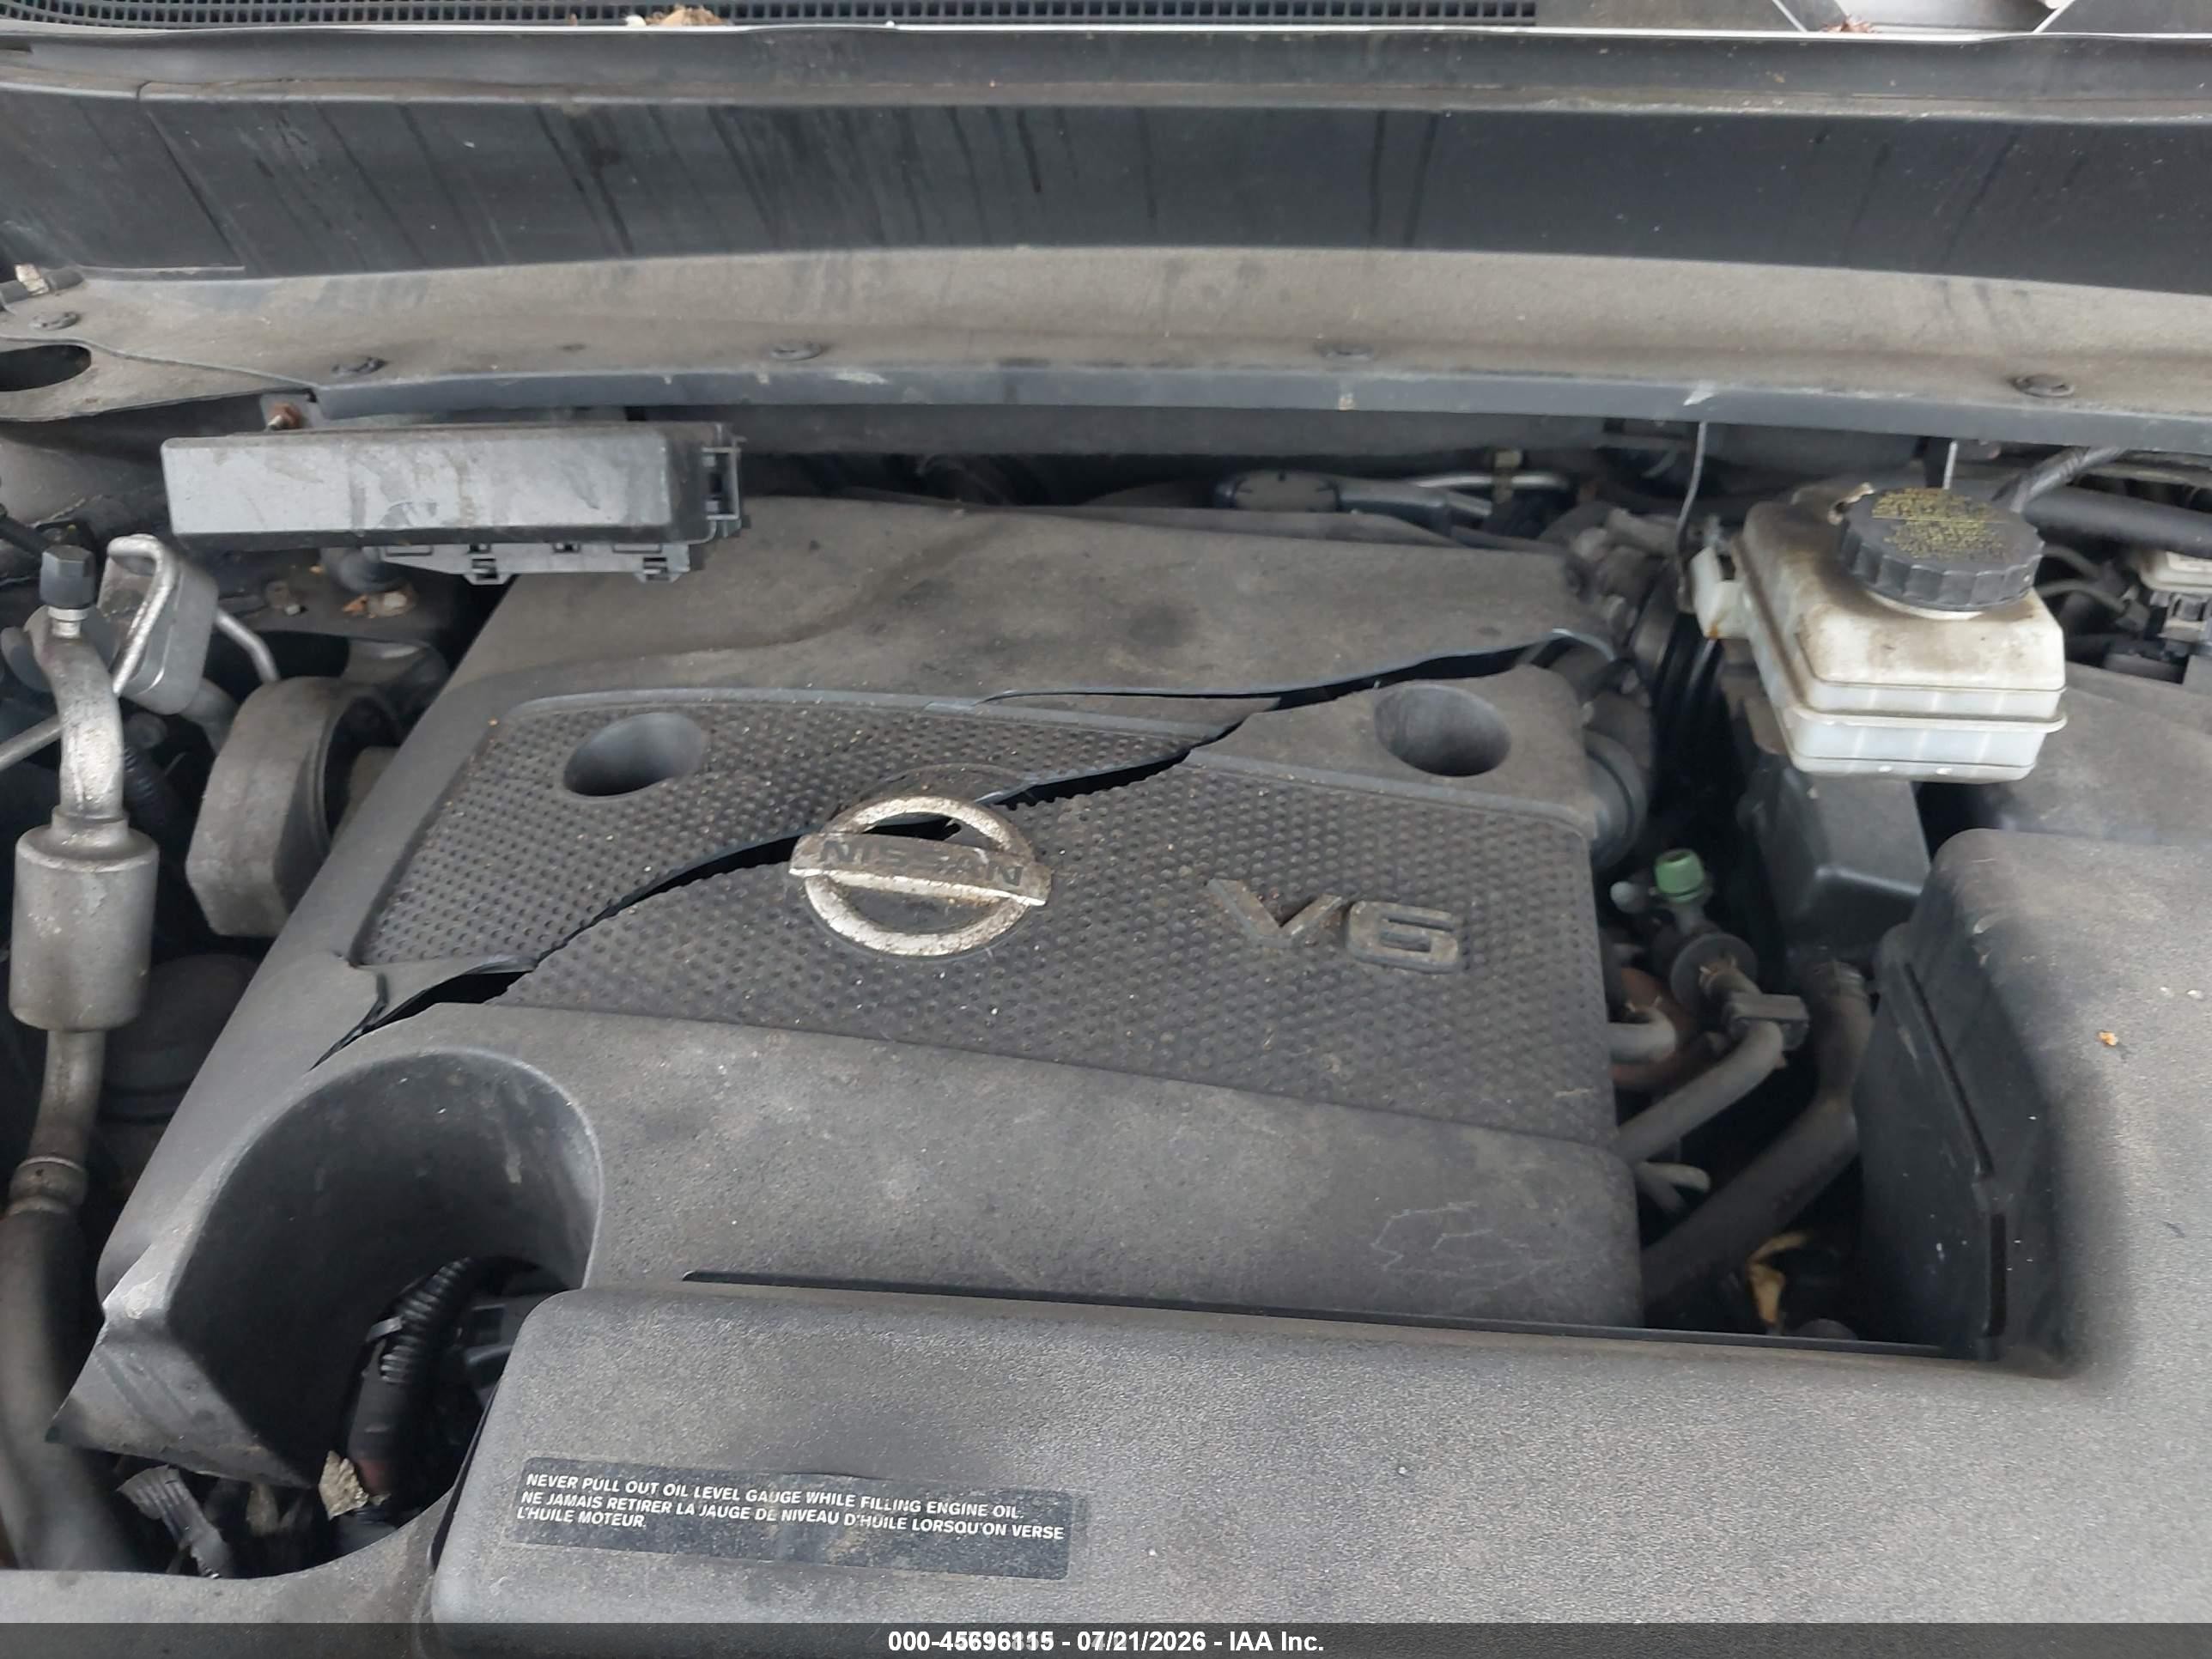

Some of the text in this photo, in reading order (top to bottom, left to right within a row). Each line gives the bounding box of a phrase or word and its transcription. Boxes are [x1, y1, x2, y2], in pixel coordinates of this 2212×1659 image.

[820, 840, 1024, 887] NISAN
[1206, 878, 1460, 975] V6
[517, 1506, 575, 1523] L'HUILE
[521, 1491, 1065, 1540] NE JAMAIS RETIRER LA JAUGE DE NIVEAU D'HUILE LORSQU'ON VERSE
[526, 1474, 579, 1489] NEVER
[581, 1477, 621, 1492] PULL
[625, 1480, 659, 1495] OUT
[663, 1484, 689, 1498] OIL
[694, 1486, 741, 1502] LEVEL
[745, 1489, 802, 1504] GAUGE
[805, 1492, 856, 1507] WHILE
[860, 1496, 921, 1513] FILLING
[927, 1501, 988, 1516] ENGINE
